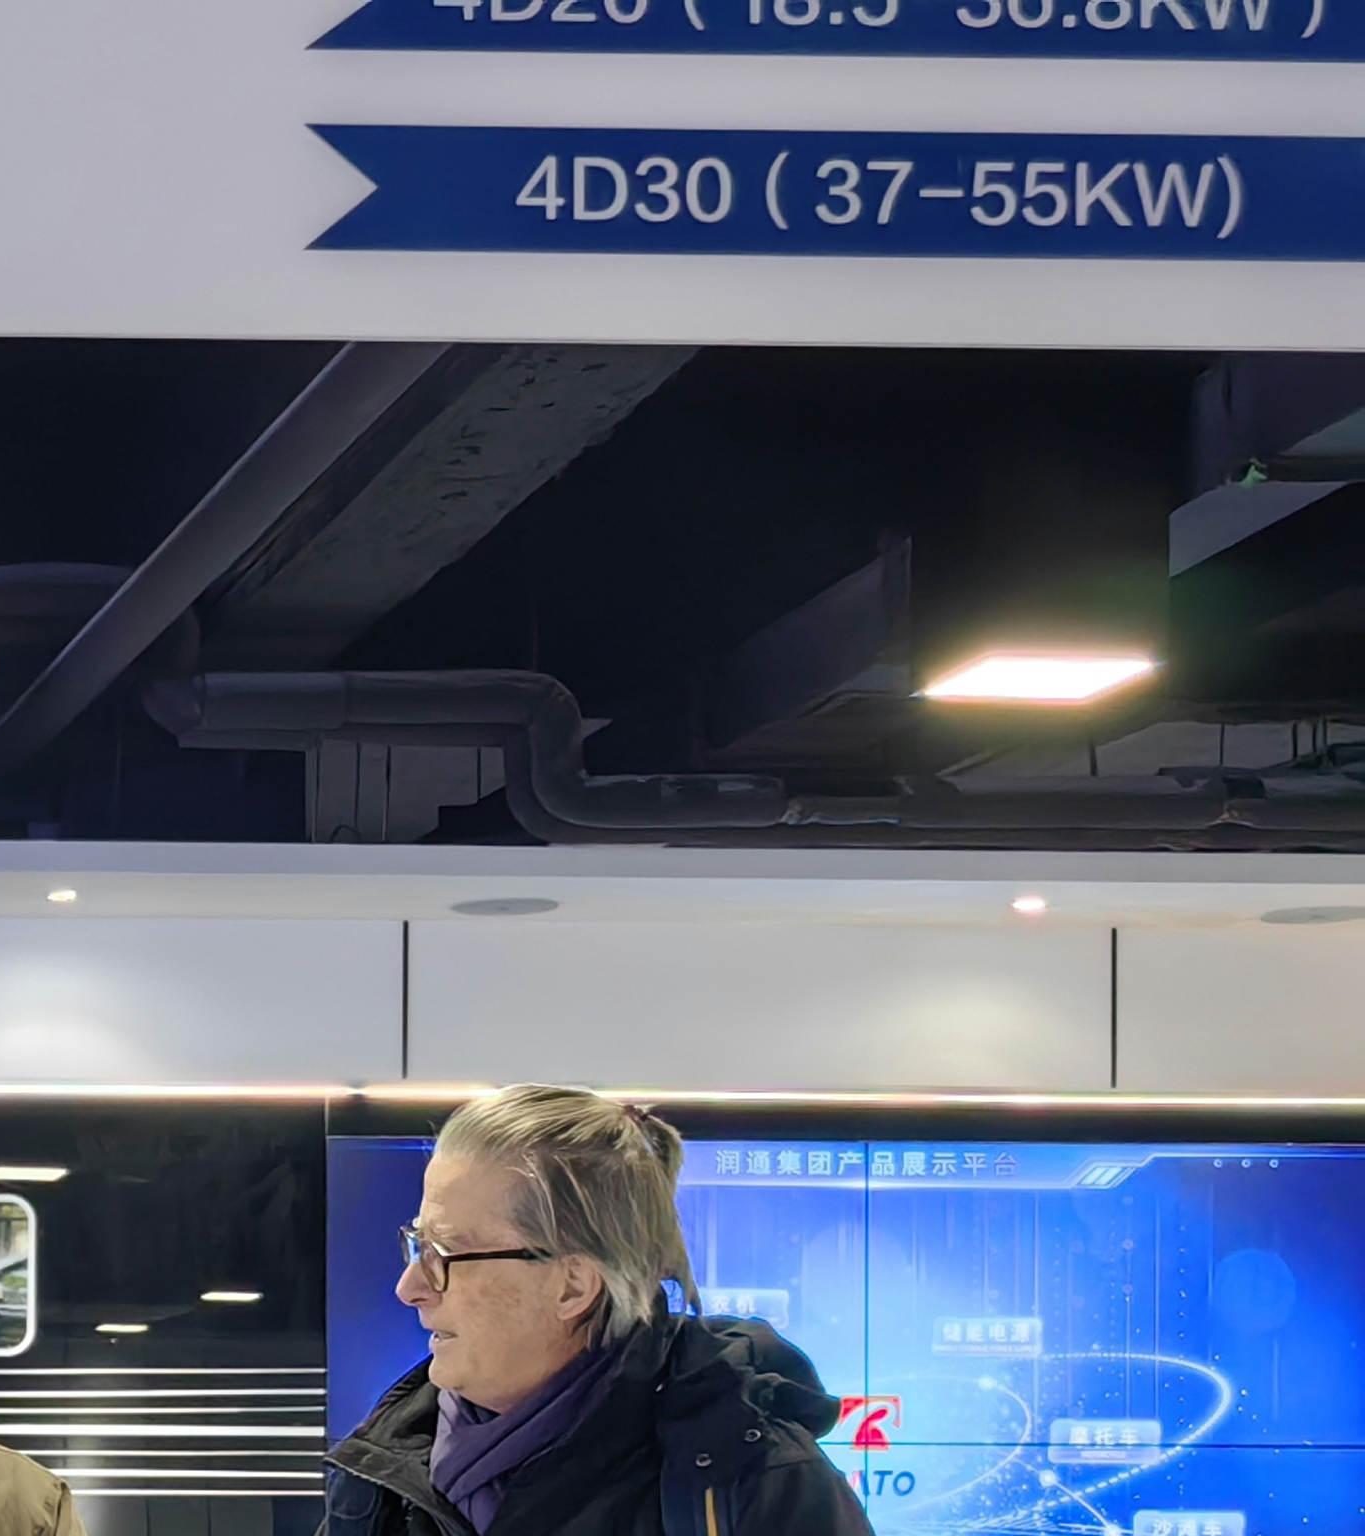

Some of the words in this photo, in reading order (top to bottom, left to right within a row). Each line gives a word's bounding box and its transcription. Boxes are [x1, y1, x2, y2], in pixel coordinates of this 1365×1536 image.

[515, 156, 733, 223] 4D30
[715, 1150, 1017, 1177] 润通集团产品展示平台
